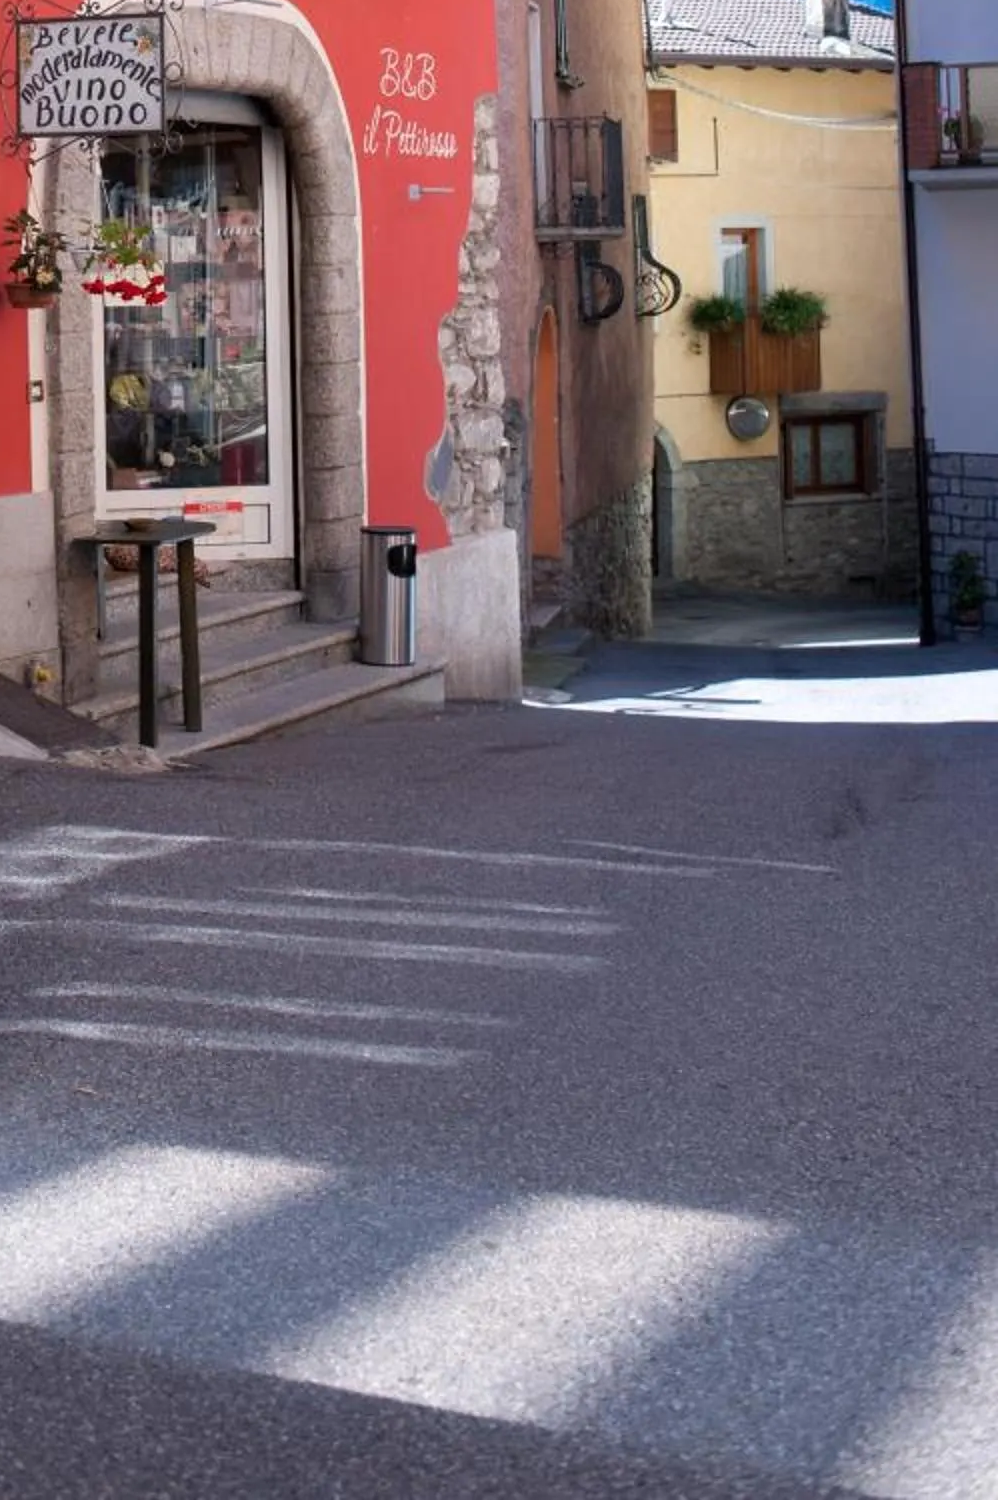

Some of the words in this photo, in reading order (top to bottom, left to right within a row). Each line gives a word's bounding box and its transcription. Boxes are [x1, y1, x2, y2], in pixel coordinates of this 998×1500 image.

[29, 21, 138, 56] Bevete
[20, 45, 163, 105] moderatamente
[379, 47, 437, 101] B&B
[35, 95, 148, 128] Buono
[364, 104, 381, 154] il
